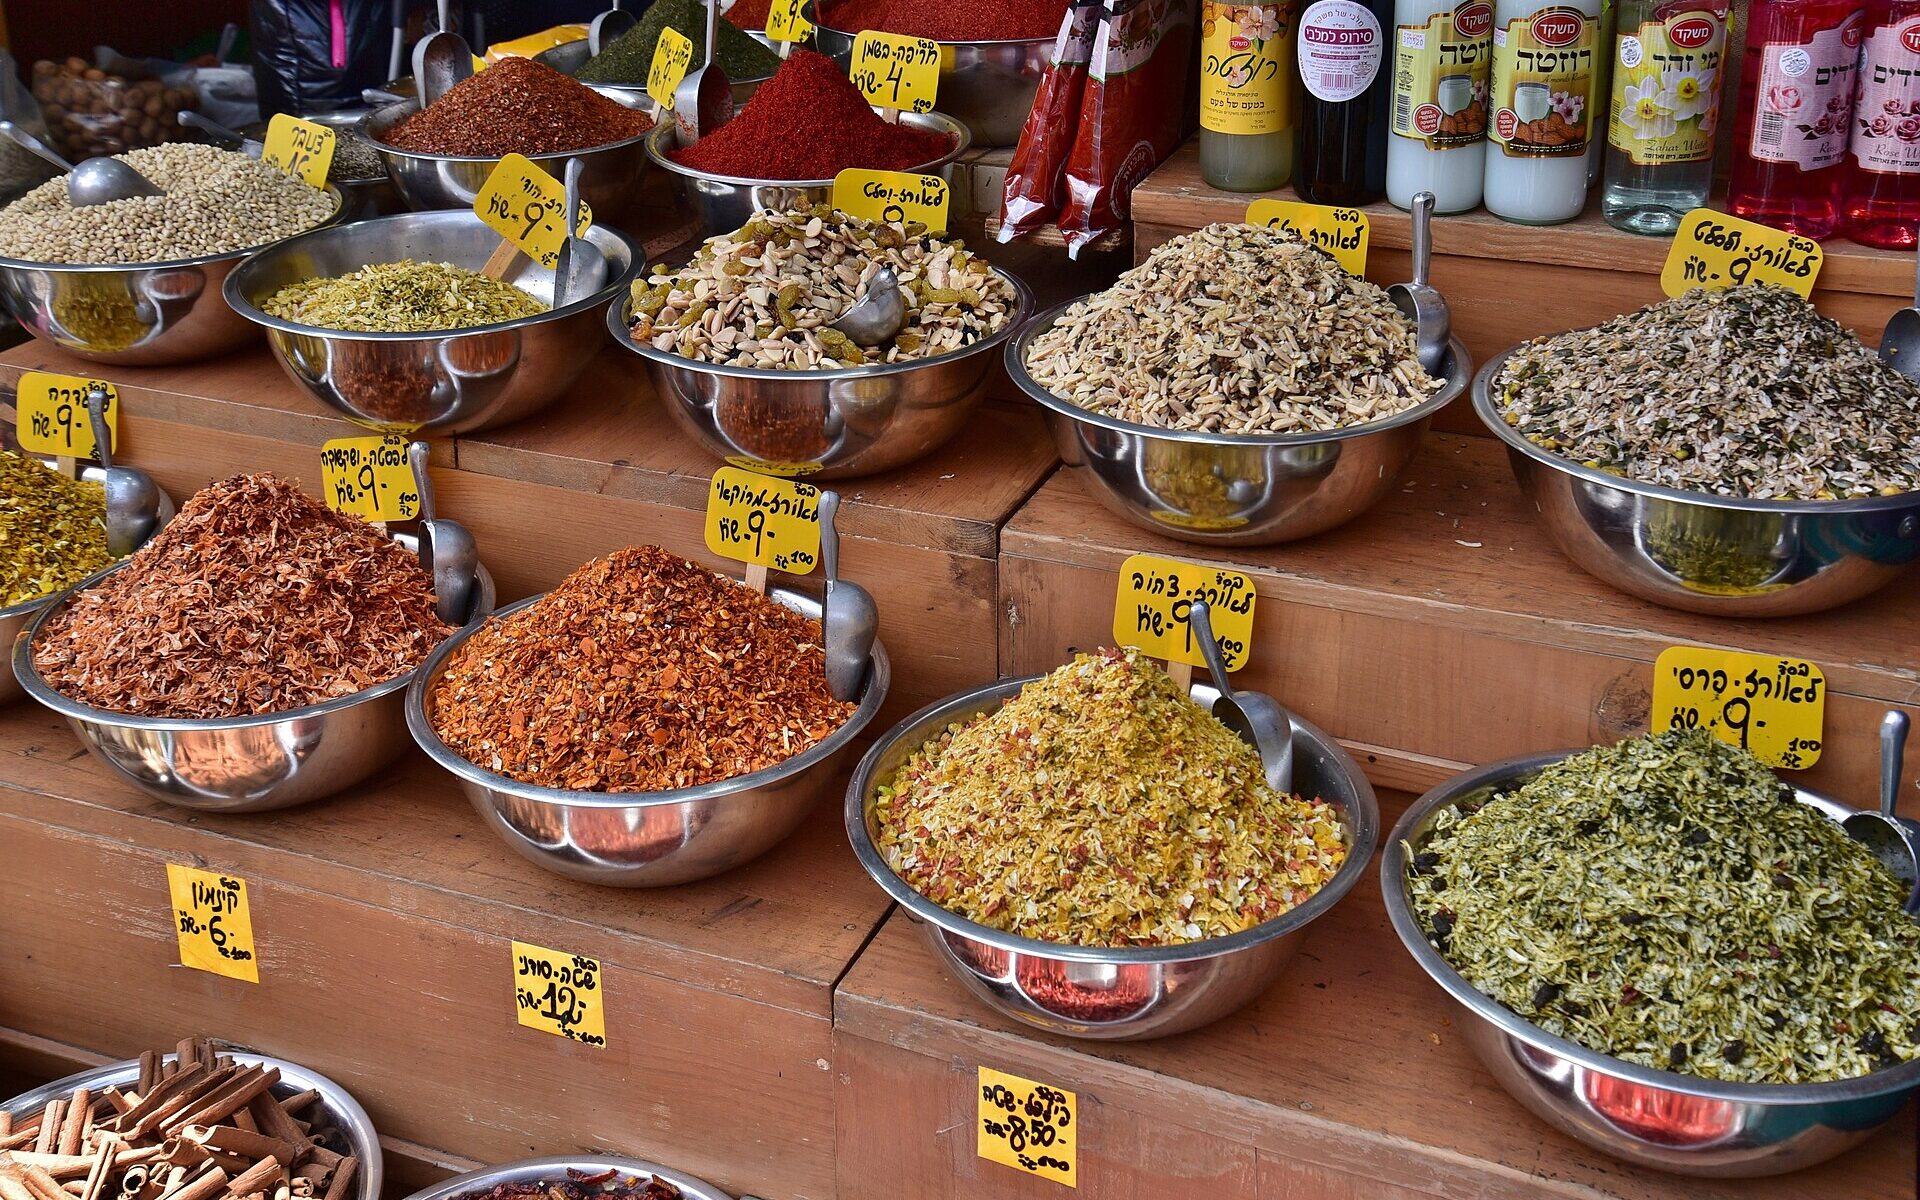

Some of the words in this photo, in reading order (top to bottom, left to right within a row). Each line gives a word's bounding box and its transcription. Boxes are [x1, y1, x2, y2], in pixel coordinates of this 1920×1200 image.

[1463, 12, 1490, 30] משקד
[1306, 28, 1336, 42] למלבי
[1340, 31, 1373, 43] סירופ
[1540, 23, 1576, 39] משקד
[1675, 27, 1709, 42] משקד
[1439, 39, 1491, 65] וזטה
[1517, 49, 1591, 72] רוזטה
[1700, 51, 1719, 69] מי
[1207, 53, 1278, 88] רוזטה
[1652, 54, 1694, 72] זהר
[1209, 98, 1225, 107] פעם
[1226, 97, 1239, 109] של
[1241, 101, 1265, 110] בטעם
[524, 202, 544, 240] 9
[57, 404, 72, 448] 9
[358, 464, 379, 512] 9
[398, 491, 418, 505] 100
[748, 509, 765, 557] 9
[790, 550, 814, 565] 100
[1723, 697, 1751, 749] 9
[1788, 737, 1821, 752] 100
[208, 915, 227, 947] 6
